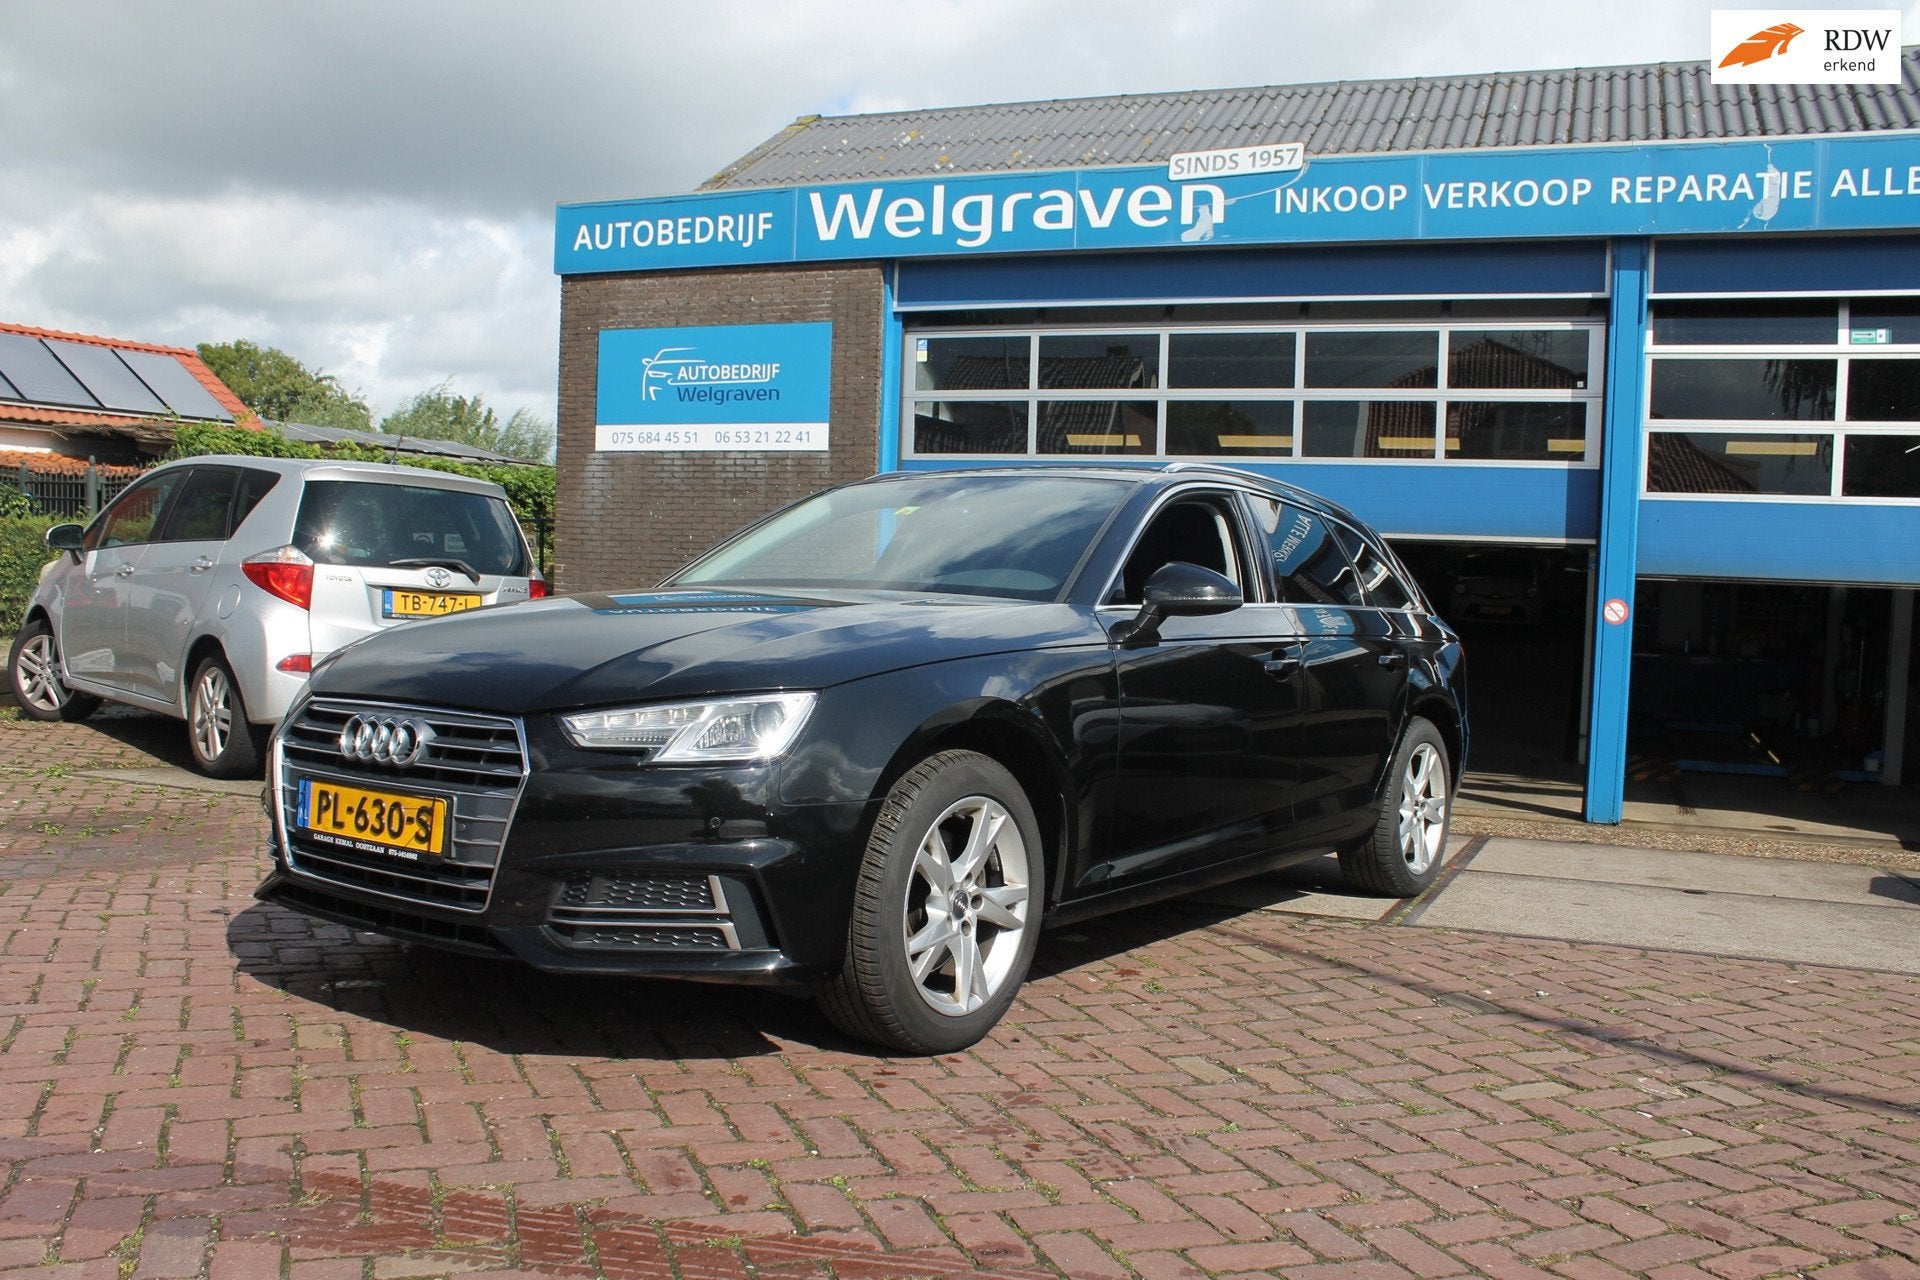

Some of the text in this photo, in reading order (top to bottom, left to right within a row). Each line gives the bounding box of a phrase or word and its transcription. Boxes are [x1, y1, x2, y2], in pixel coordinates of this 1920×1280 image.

[1173, 148, 1299, 176] SINDS 1957
[573, 165, 1920, 252] AUTOBEDRIJF Welgraven INKOOP VERKOOP REPARATIE ALLE
[677, 363, 780, 382] AUTOBEDRIJF
[676, 386, 780, 406] Welgraven
[611, 431, 811, 444] 075 684 45 51 06 53 21 22 41
[316, 789, 433, 844] PL-630-S
